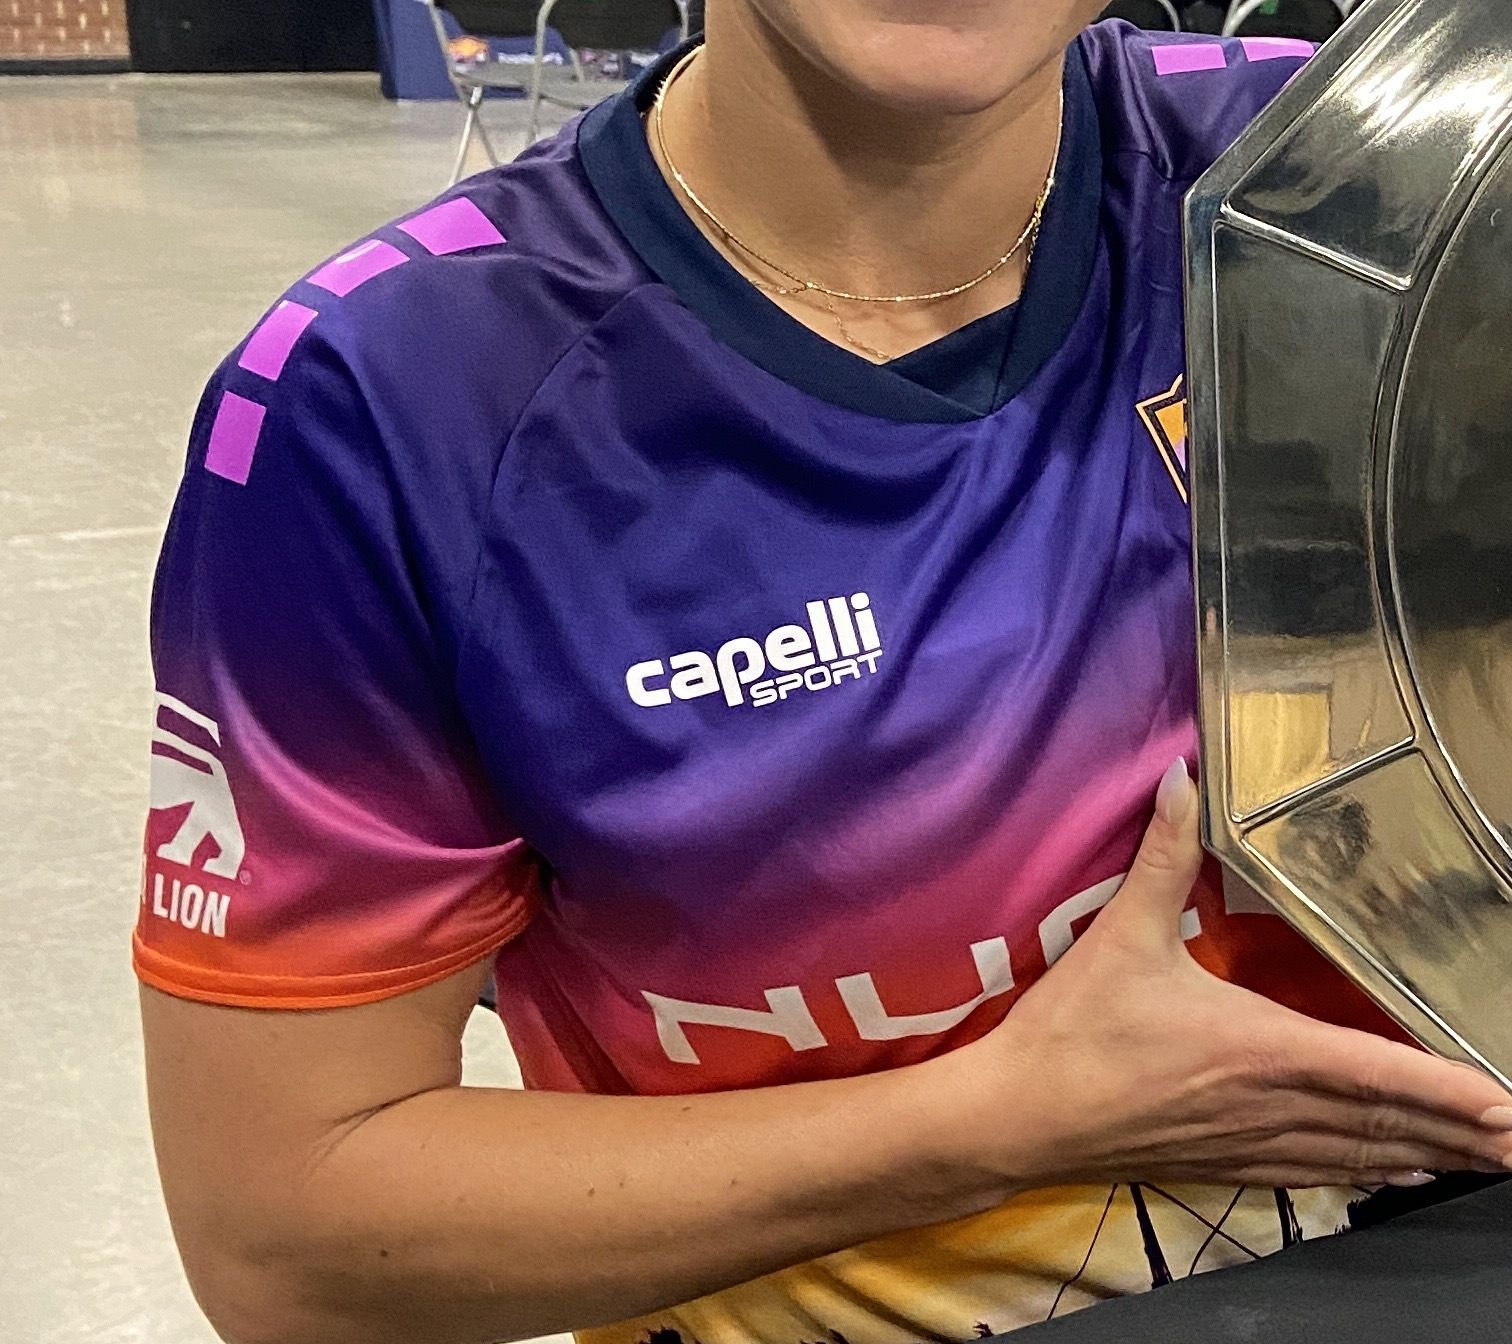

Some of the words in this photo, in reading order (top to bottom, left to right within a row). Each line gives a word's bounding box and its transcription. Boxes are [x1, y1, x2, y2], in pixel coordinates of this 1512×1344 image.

[626, 592, 880, 707] capelli
[750, 649, 883, 707] SPORT
[153, 873, 230, 937] LION
